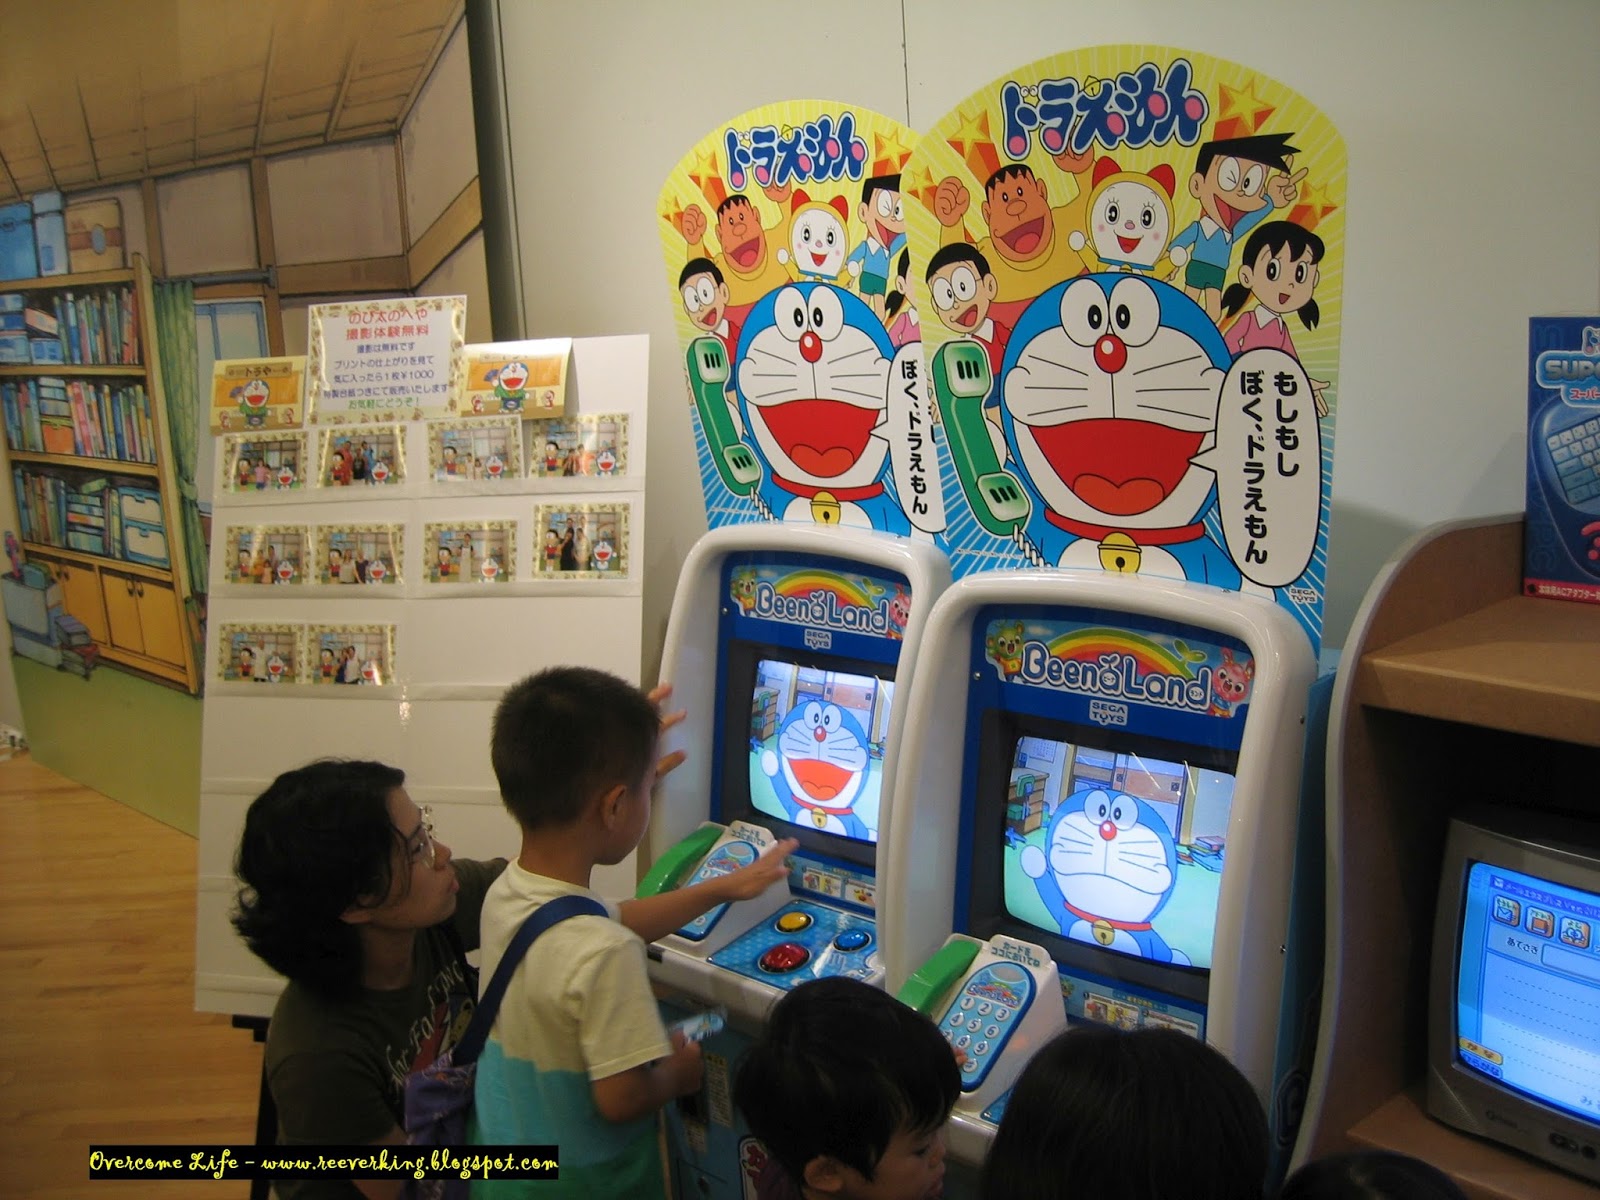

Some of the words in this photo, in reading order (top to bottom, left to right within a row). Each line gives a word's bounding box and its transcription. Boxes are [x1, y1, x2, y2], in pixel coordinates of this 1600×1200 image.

[1000, 58, 1210, 161] ドラえもん
[724, 111, 869, 192] ドラえもん
[348, 308, 428, 324] のび太のへや
[346, 324, 429, 341] 撮影体験無料
[1274, 371, 1300, 477] もしもし
[902, 359, 928, 515] ぼく、ドラえもん
[1240, 370, 1268, 564] ぼく、ドラえもん
[1290, 588, 1316, 597] SEGA
[1290, 594, 1316, 603] TOYS
[806, 631, 830, 640] SEGA
[806, 638, 830, 648] TOYS
[1092, 701, 1125, 713] SEGA
[1092, 711, 1125, 723] TOYS
[1003, 941, 1032, 956] カードを
[1507, 937, 1539, 955] あてさき
[990, 947, 1041, 968] ココにおいてね
[964, 998, 972, 1006] 1
[981, 1003, 989, 1012] 2
[997, 1009, 1007, 1019] 3
[951, 1015, 959, 1023] 4
[969, 1020, 977, 1029] 5
[987, 1026, 996, 1035] 6
[958, 1037, 968, 1046] 8
[976, 1043, 985, 1052] 9
